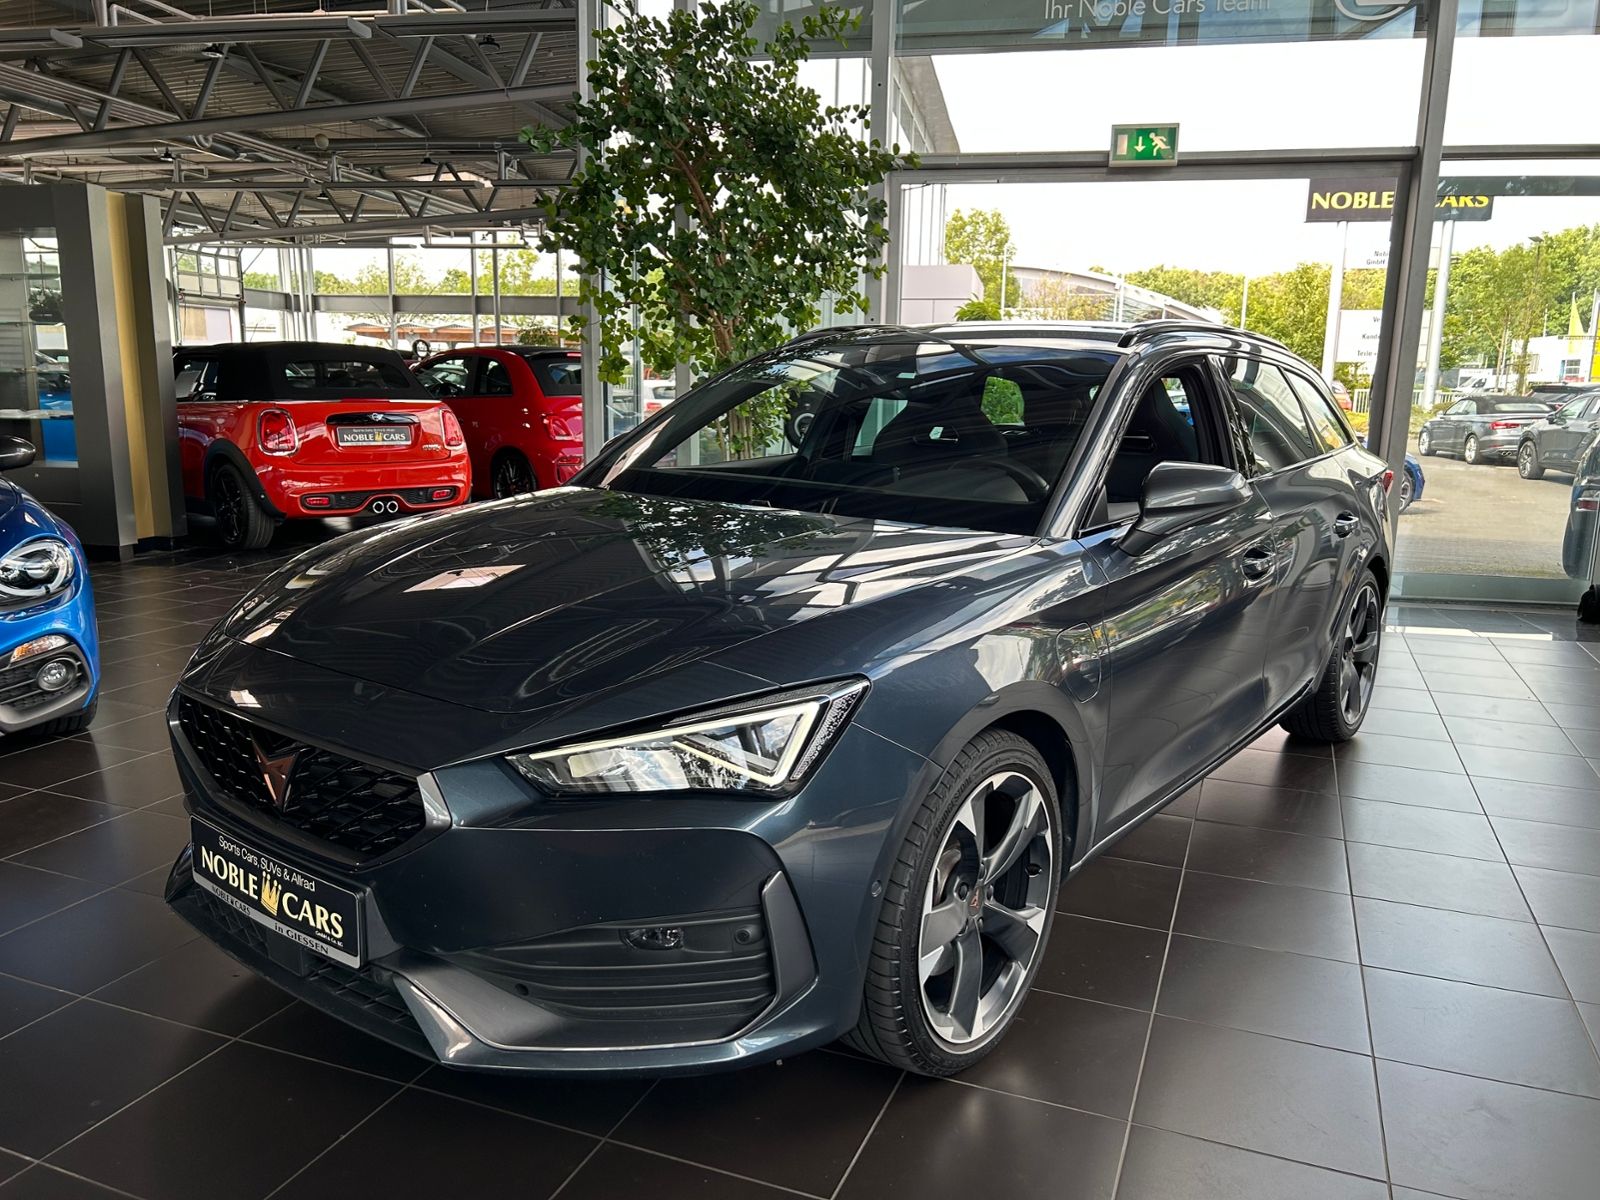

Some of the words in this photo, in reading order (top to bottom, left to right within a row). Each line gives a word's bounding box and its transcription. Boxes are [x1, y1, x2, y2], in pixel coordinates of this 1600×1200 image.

[1045, 0, 1072, 19] Ihr
[1079, 0, 1146, 18] Noble
[1152, 0, 1205, 15] Cars
[1312, 192, 1394, 209] NOBLE
[1435, 196, 1489, 208] ARS
[343, 433, 374, 442] NOBLE
[383, 433, 406, 441] CARS
[219, 835, 240, 857] Sports
[241, 848, 260, 868] Cars,
[260, 857, 282, 877] SUVs
[283, 868, 290, 881] &
[290, 872, 316, 892] Allrad
[201, 845, 259, 900] NOBLE
[282, 892, 344, 939] CARS
[274, 922, 284, 933] in
[286, 929, 329, 955] GIESSEN
